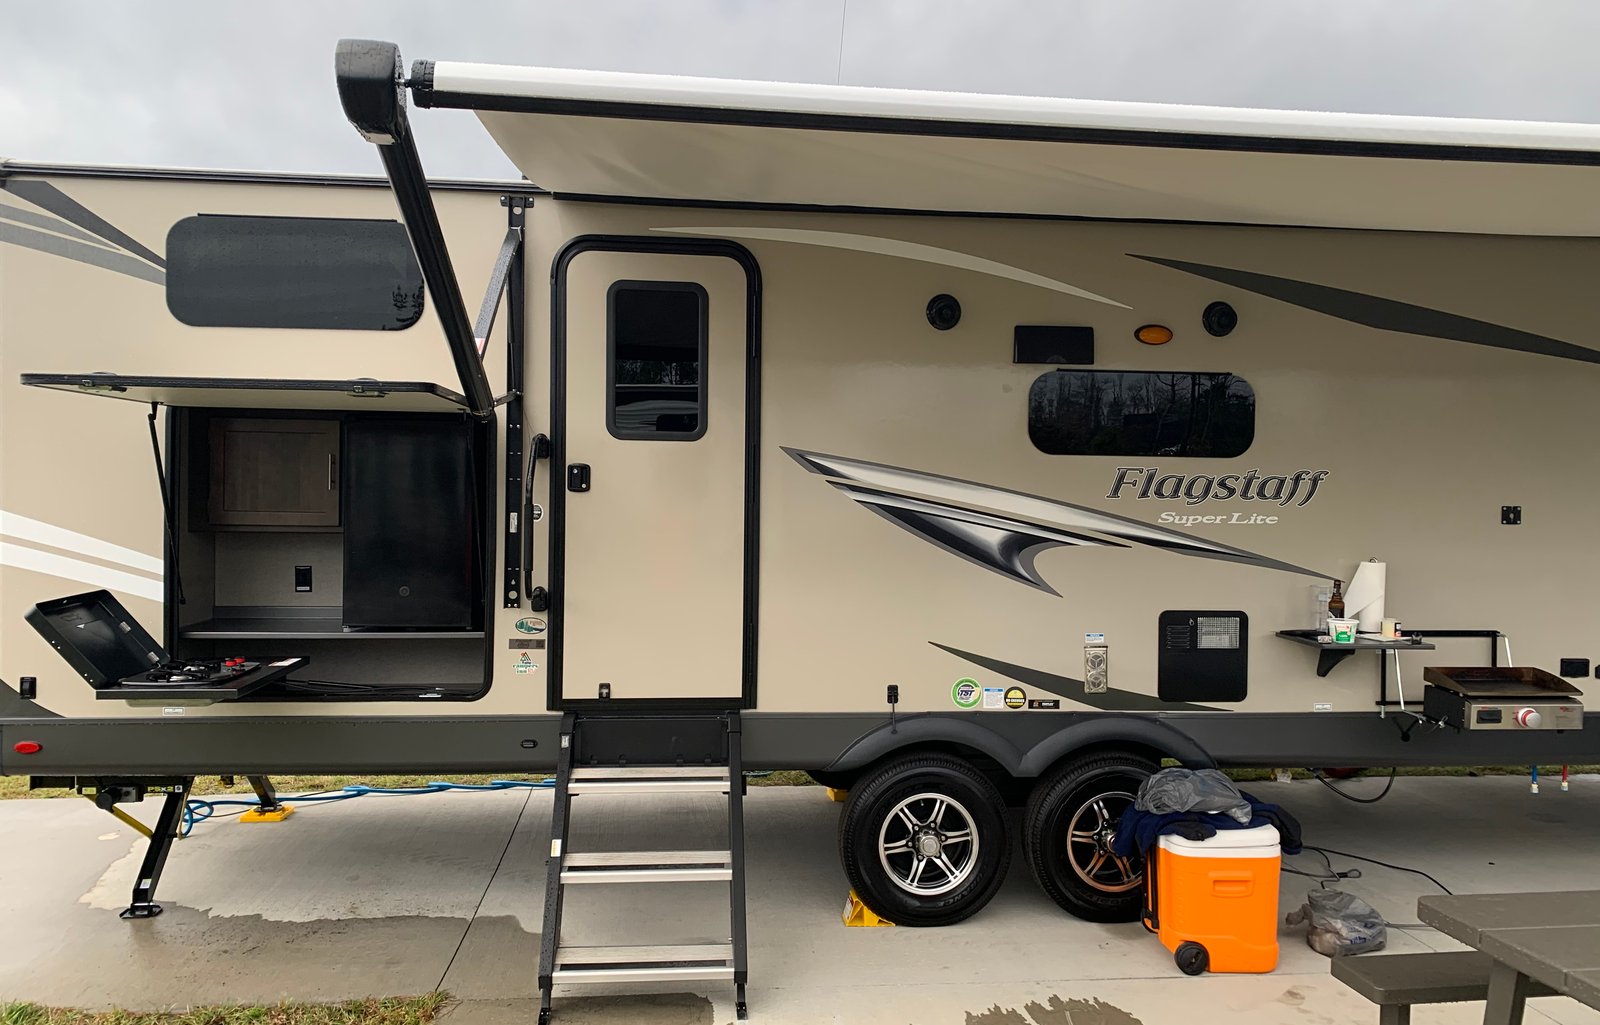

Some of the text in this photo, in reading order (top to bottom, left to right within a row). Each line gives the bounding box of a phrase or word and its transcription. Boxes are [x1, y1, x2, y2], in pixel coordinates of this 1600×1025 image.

[1106, 466, 1330, 507] Flagstaff
[1157, 511, 1279, 527] Super Lite
[959, 689, 975, 697] TST
